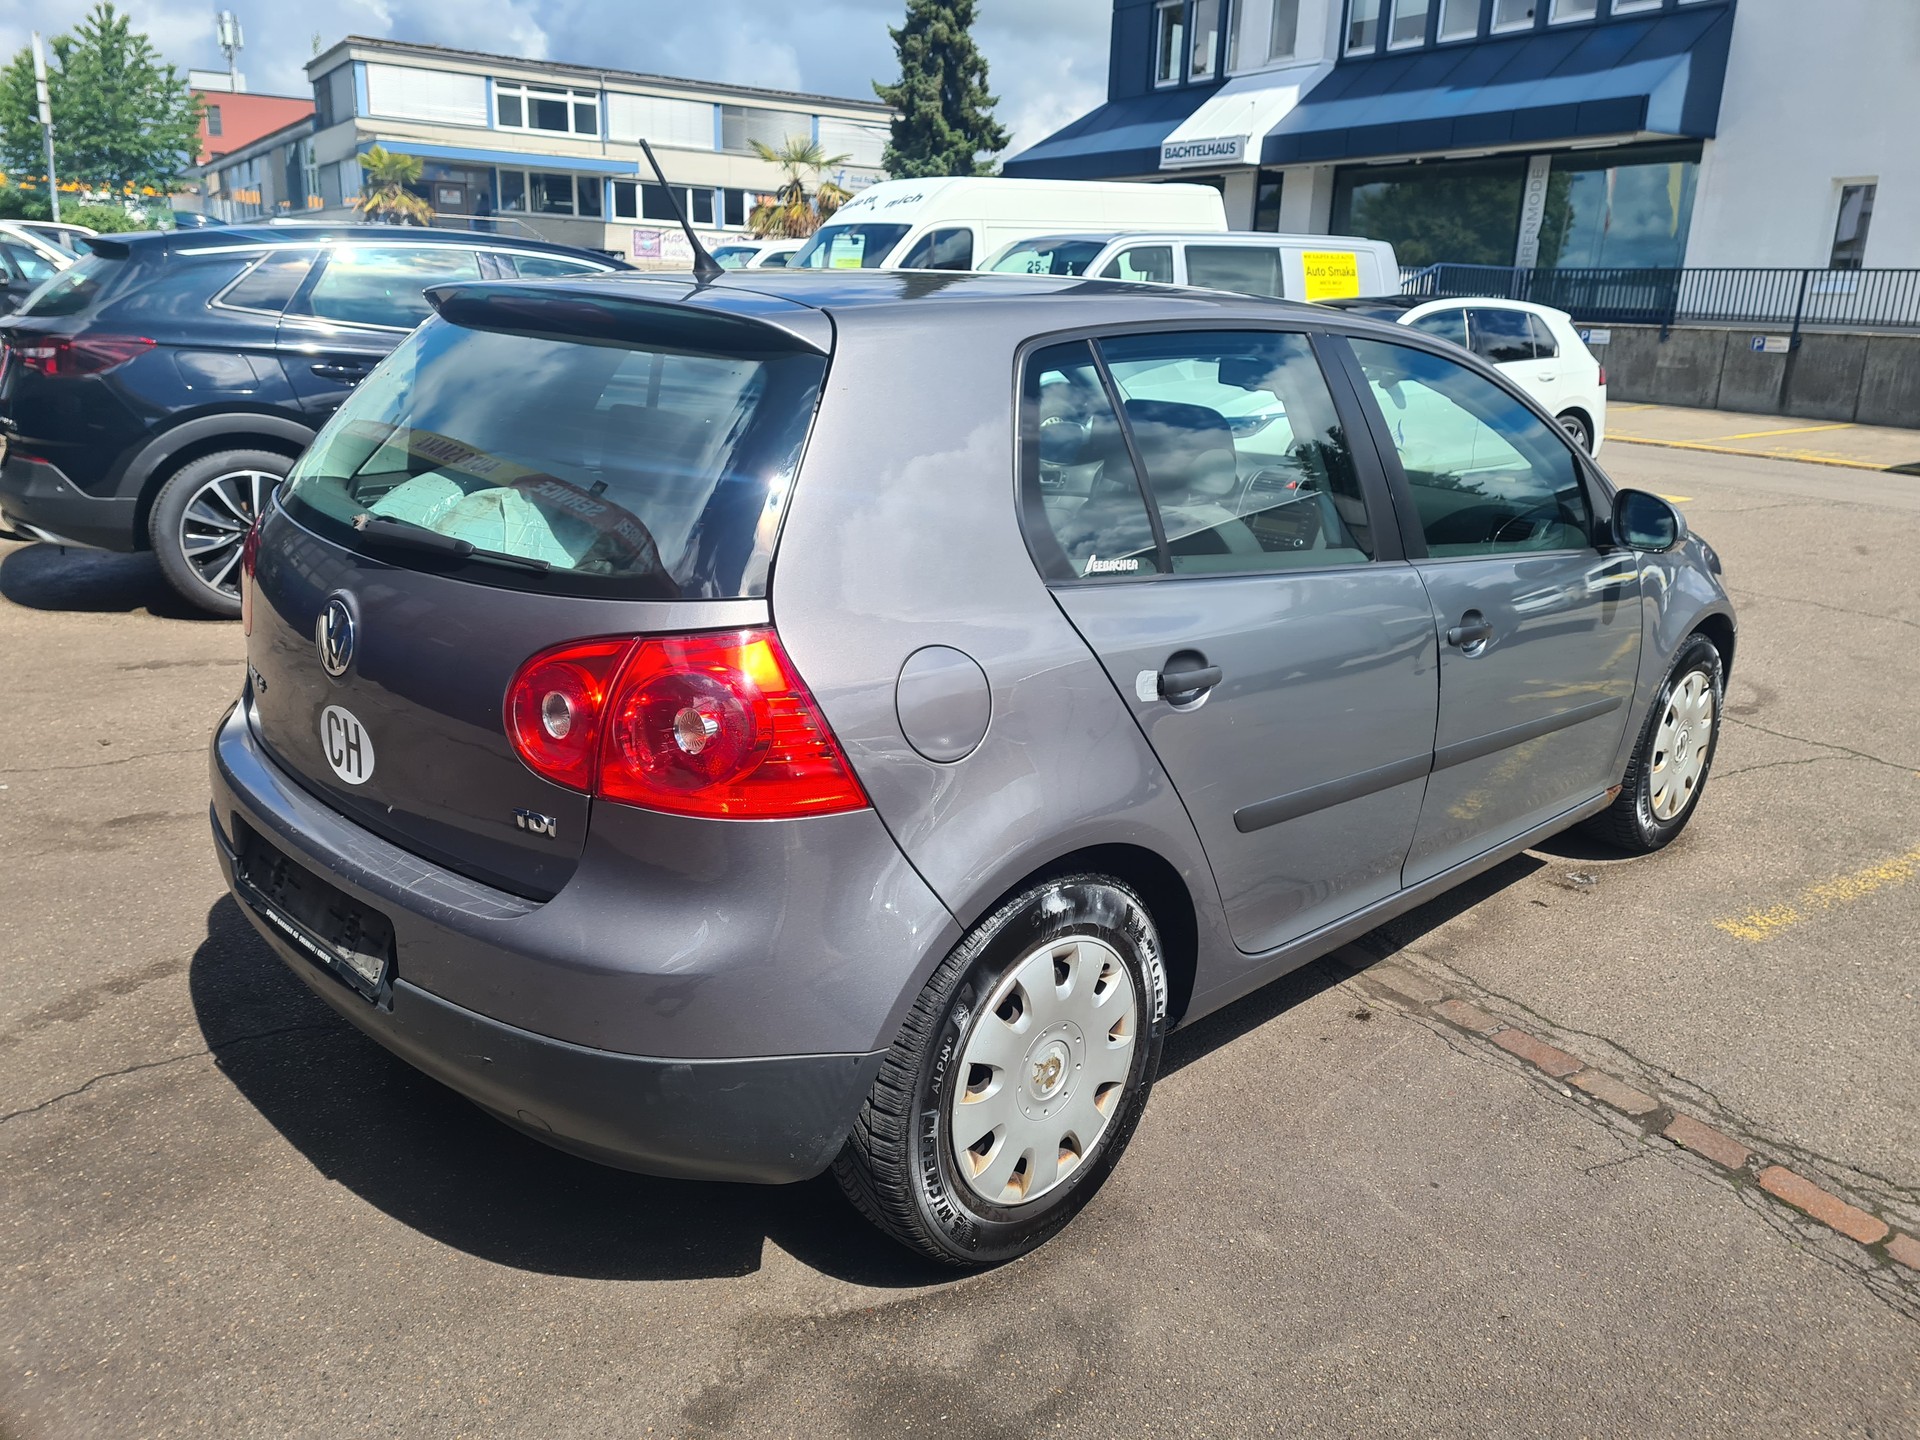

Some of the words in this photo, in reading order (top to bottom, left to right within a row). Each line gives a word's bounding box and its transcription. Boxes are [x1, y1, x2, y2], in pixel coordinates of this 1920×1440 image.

[1165, 142, 1236, 159] BACHTELHAUS
[1306, 266, 1326, 277] Auto
[1328, 266, 1356, 277] Smaka
[327, 710, 363, 778] CH
[512, 808, 557, 838] TDI
[931, 1044, 951, 1095] ALPIN
[920, 1113, 955, 1226] MICHELIN
